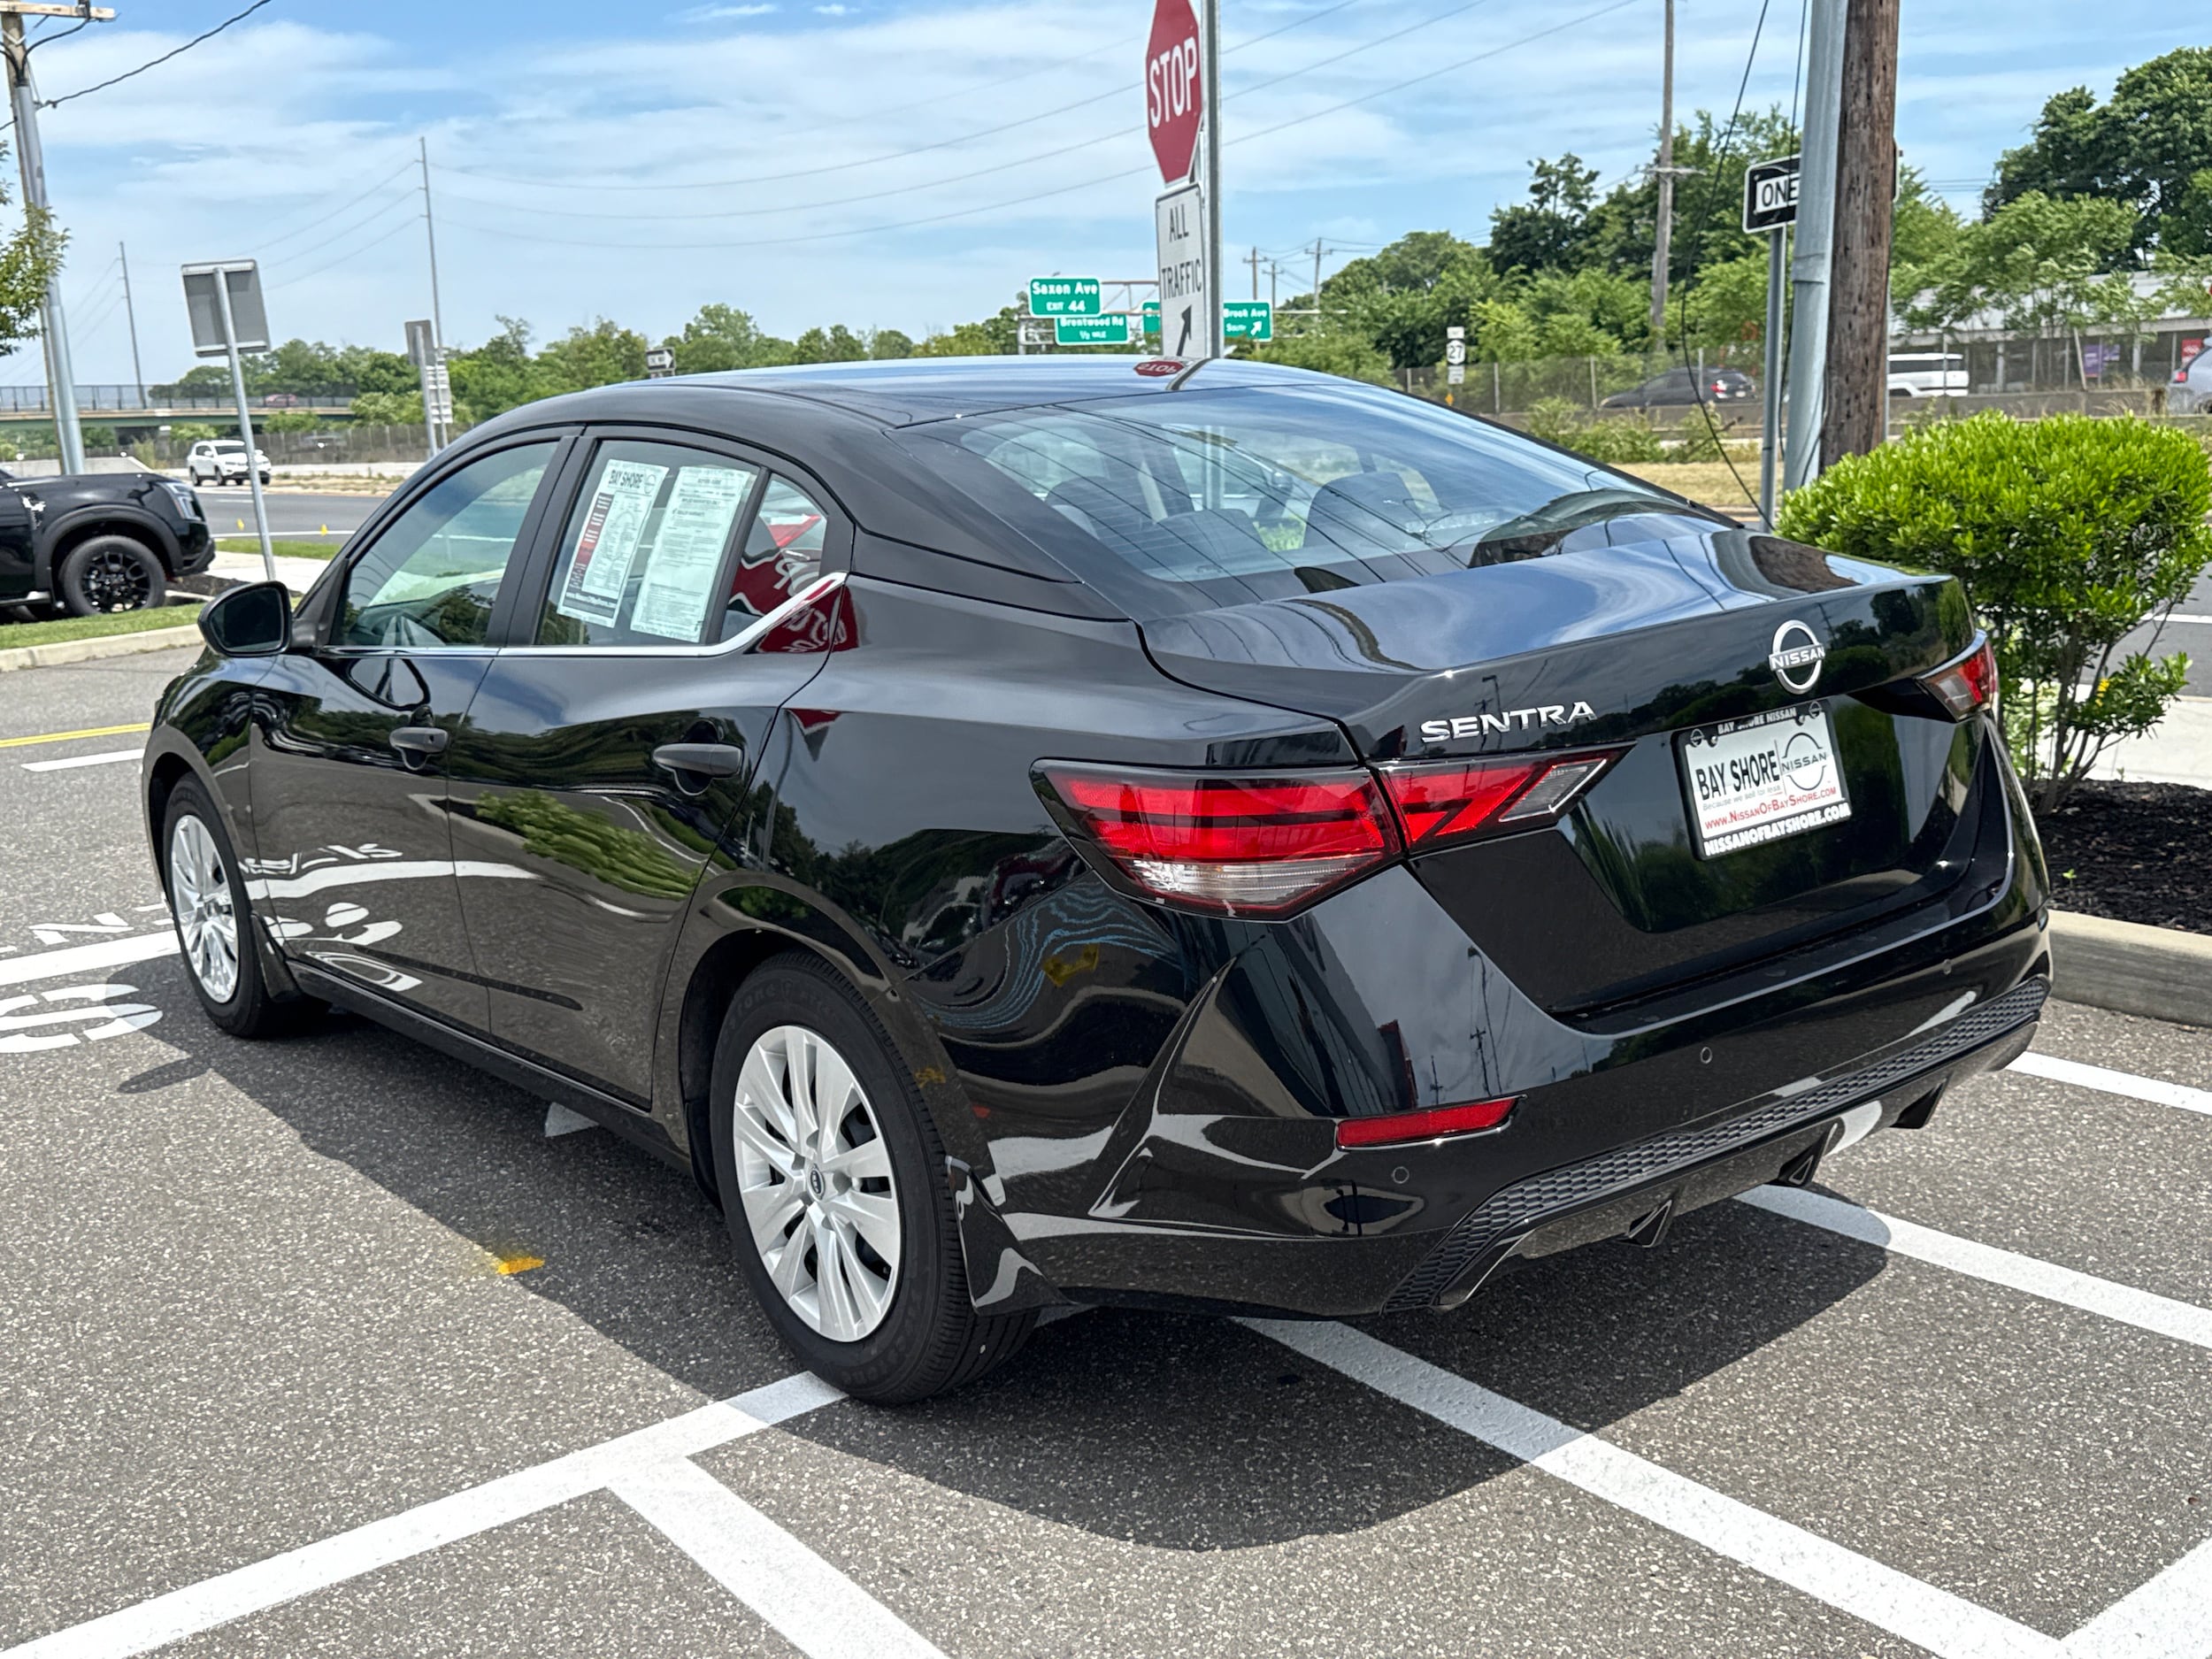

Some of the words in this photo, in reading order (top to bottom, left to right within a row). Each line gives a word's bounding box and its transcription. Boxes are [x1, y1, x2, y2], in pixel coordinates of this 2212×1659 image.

[1149, 36, 1197, 128] STOP
[1762, 179, 1801, 206] ONE
[1169, 204, 1189, 242] ALL
[1032, 281, 1071, 295] Saxon
[1074, 281, 1098, 295] Ave
[1161, 258, 1202, 300] TRAFFIC
[1068, 300, 1086, 312] 44
[1250, 308, 1267, 319] Ave
[1060, 316, 1110, 327] Brentwood
[1111, 316, 1125, 326] Rd
[1448, 345, 1463, 359] 27
[1770, 647, 1826, 670] NISSAN
[1420, 701, 1598, 743] SENTRA
[1717, 721, 1735, 735] BAY
[1766, 707, 1797, 724] NISSAN
[1695, 762, 1726, 801] BAY
[1730, 750, 1780, 792] SHORE
[1782, 752, 1828, 772] NISSAN
[1703, 803, 1852, 856] NISSANOFBAYSHORE.COM
